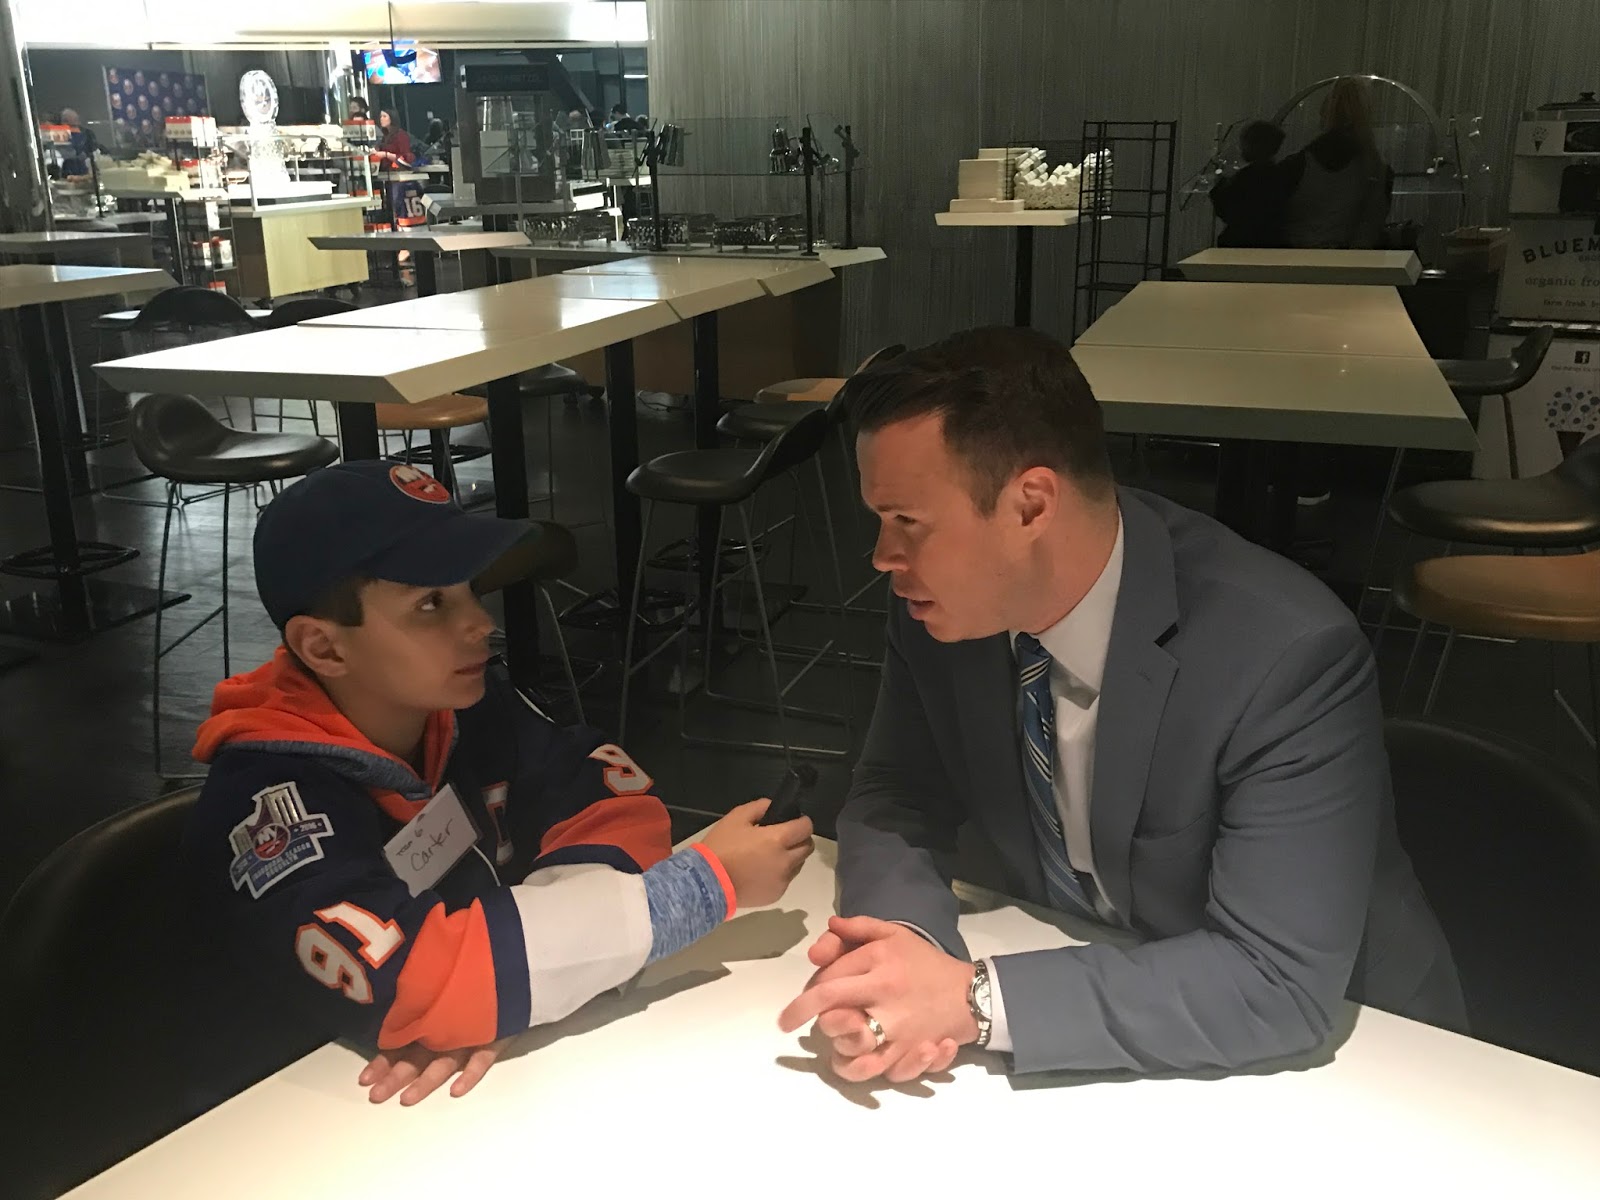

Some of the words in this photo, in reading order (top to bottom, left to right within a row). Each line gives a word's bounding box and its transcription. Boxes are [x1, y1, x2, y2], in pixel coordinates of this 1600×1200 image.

[404, 196, 424, 218] 16
[410, 818, 453, 872] Carter
[295, 900, 406, 1004] 91
